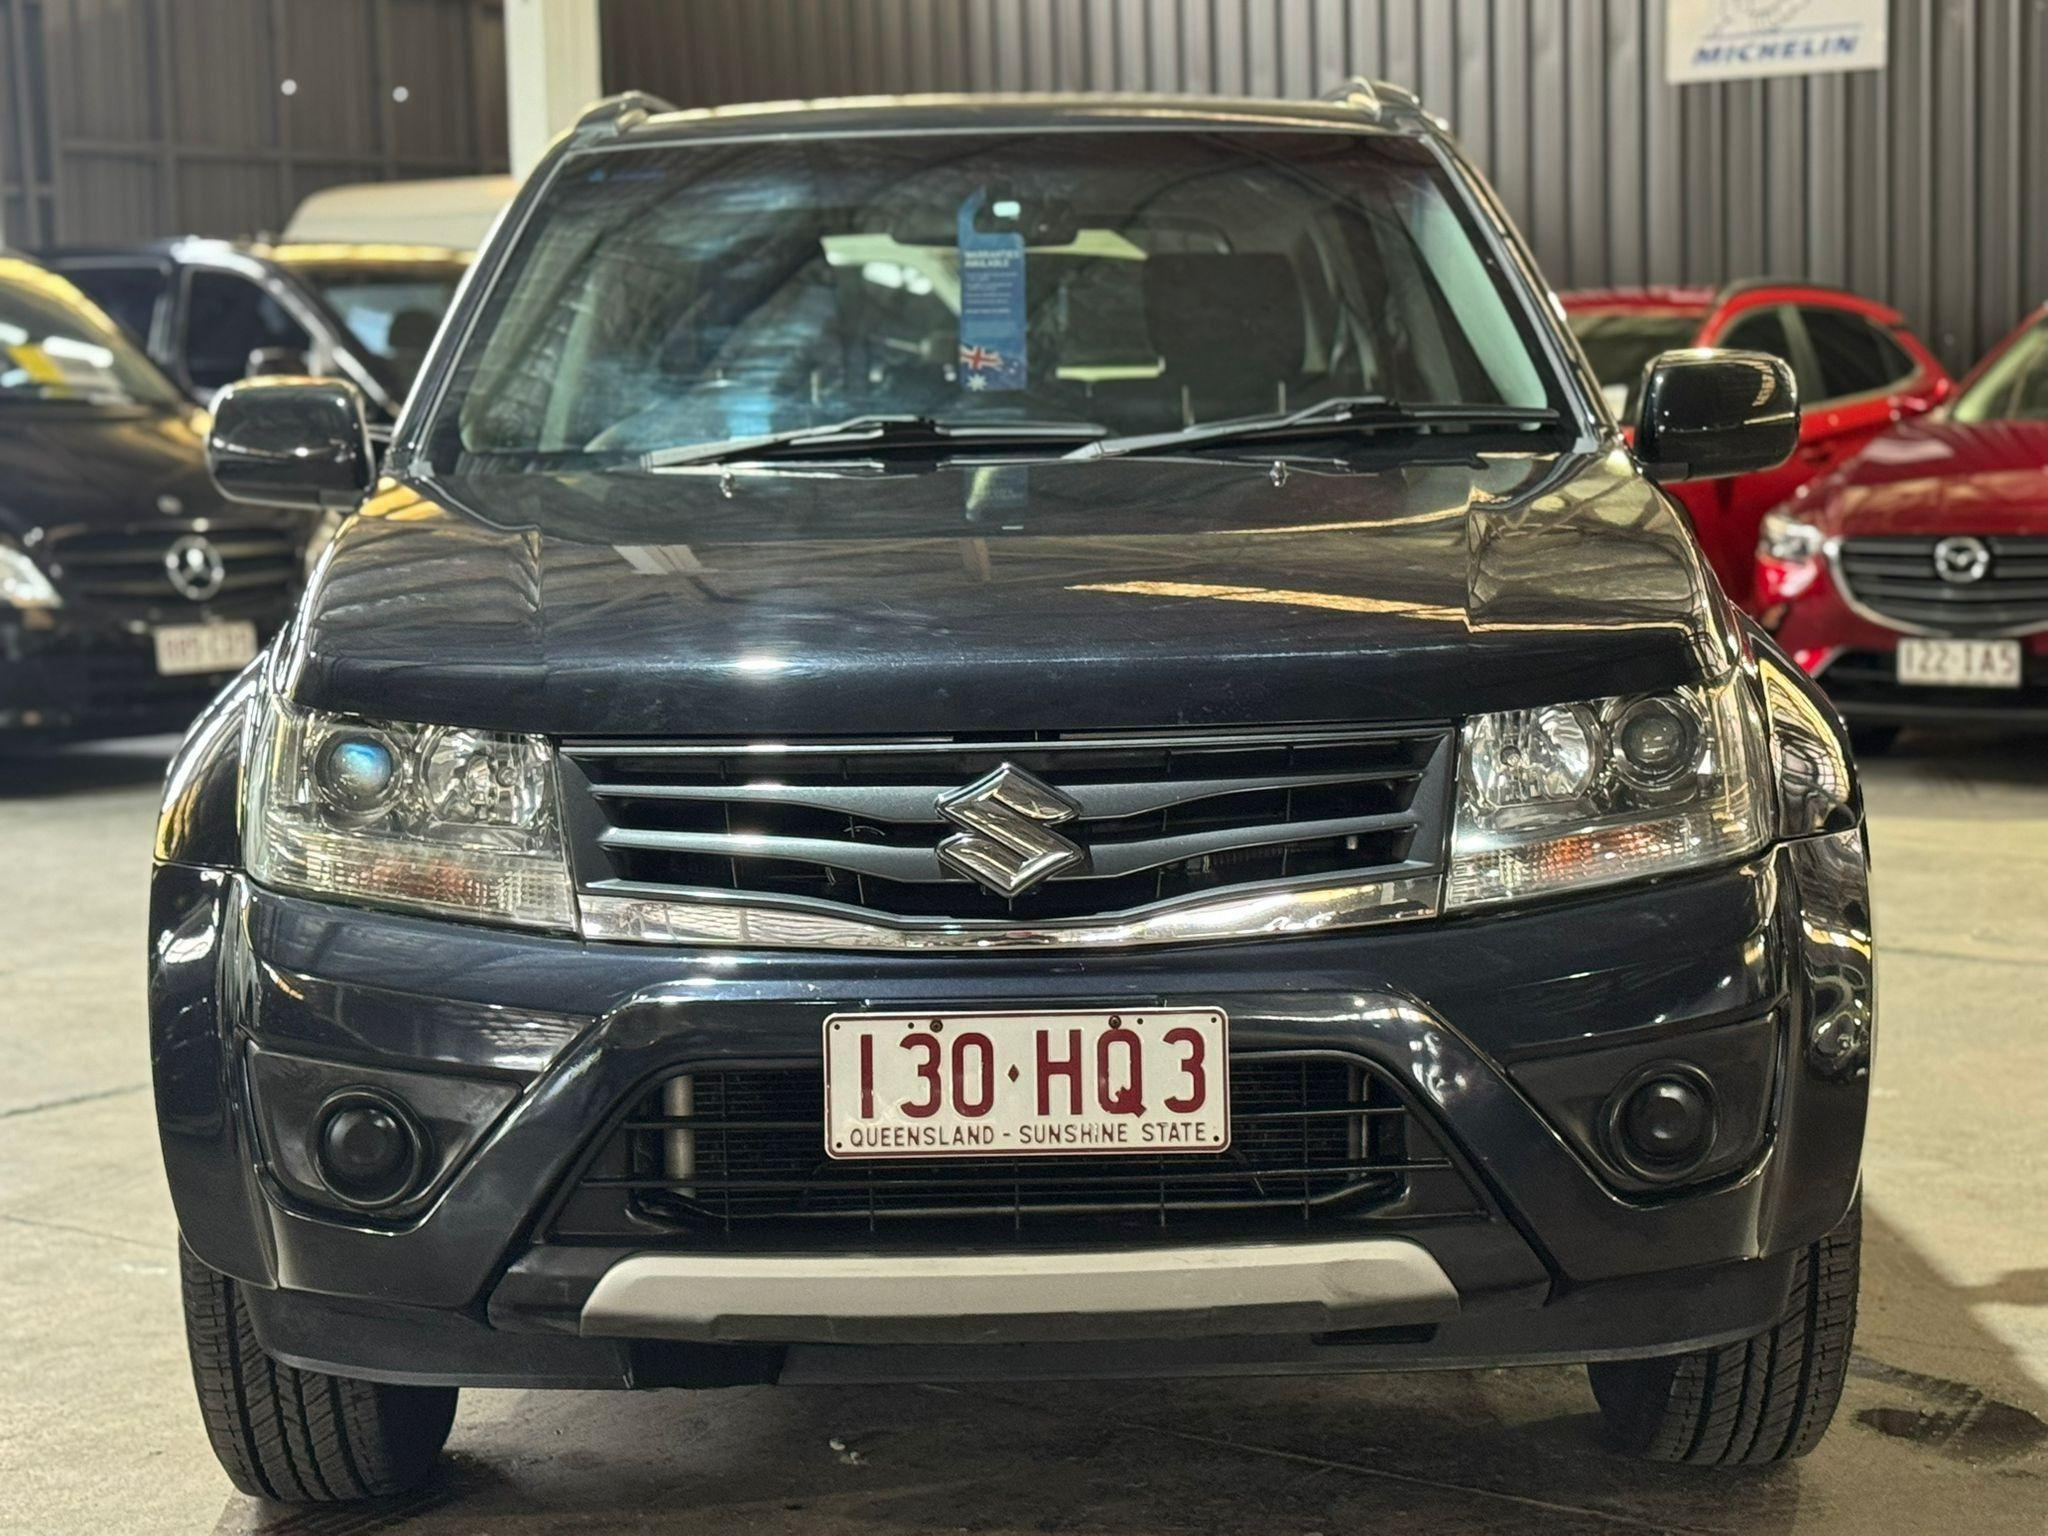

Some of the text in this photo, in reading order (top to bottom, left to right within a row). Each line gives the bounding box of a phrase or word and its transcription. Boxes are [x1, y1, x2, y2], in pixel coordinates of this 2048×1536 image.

[1692, 36, 1859, 65] MICHELIN
[1036, 1027, 1206, 1118] HQ3
[850, 1126, 994, 1148] QUEENSLAND
[1019, 1123, 1128, 1144] SUNSHINE
[1141, 1122, 1207, 1142] STATE
